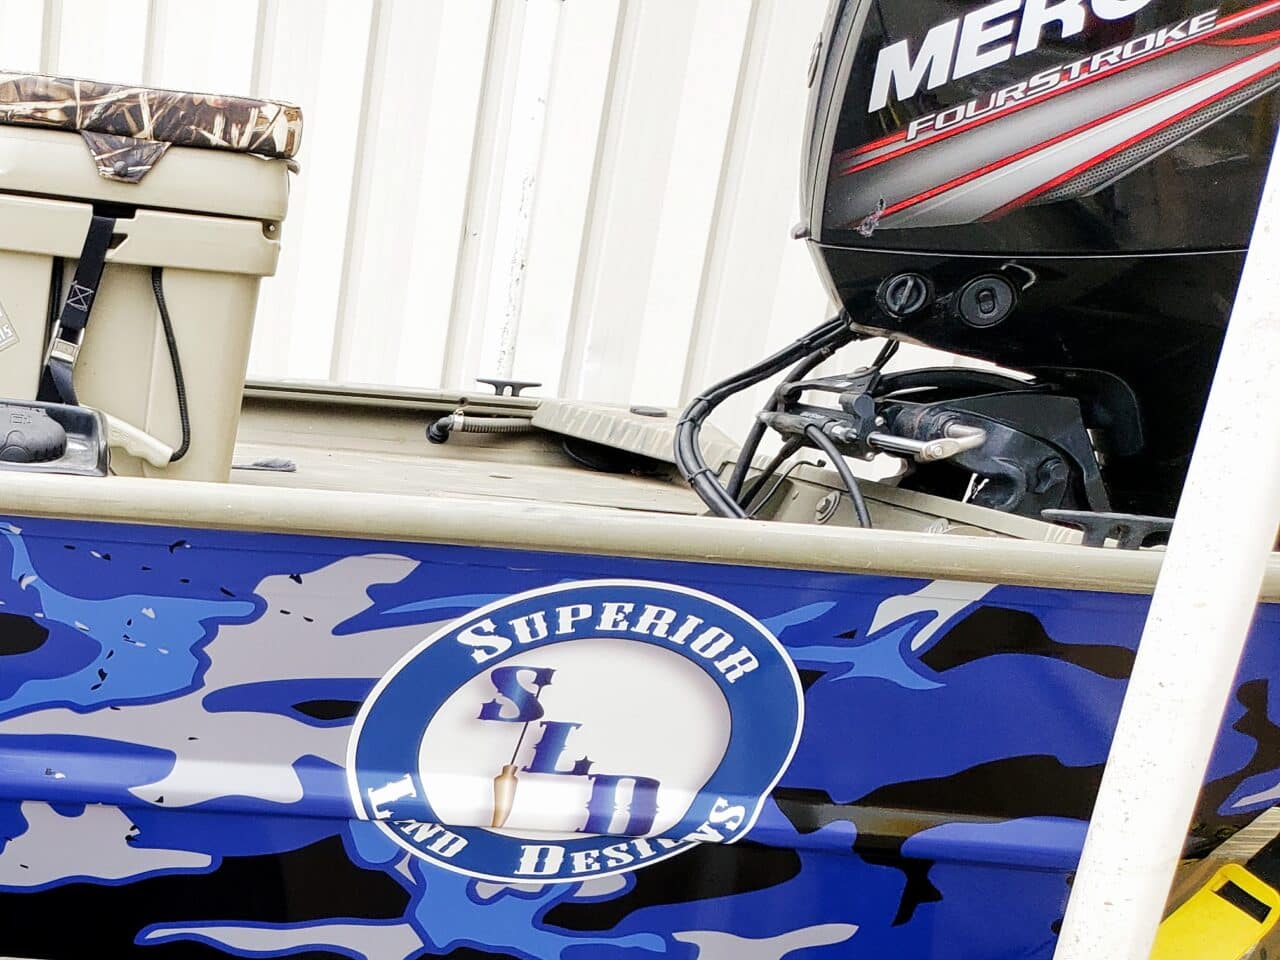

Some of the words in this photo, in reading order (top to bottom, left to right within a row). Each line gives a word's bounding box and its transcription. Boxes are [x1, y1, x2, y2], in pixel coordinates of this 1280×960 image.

[906, 9, 1218, 141] FOURSTROKE
[456, 602, 760, 684] SUPERIOR
[368, 773, 469, 859] LND
